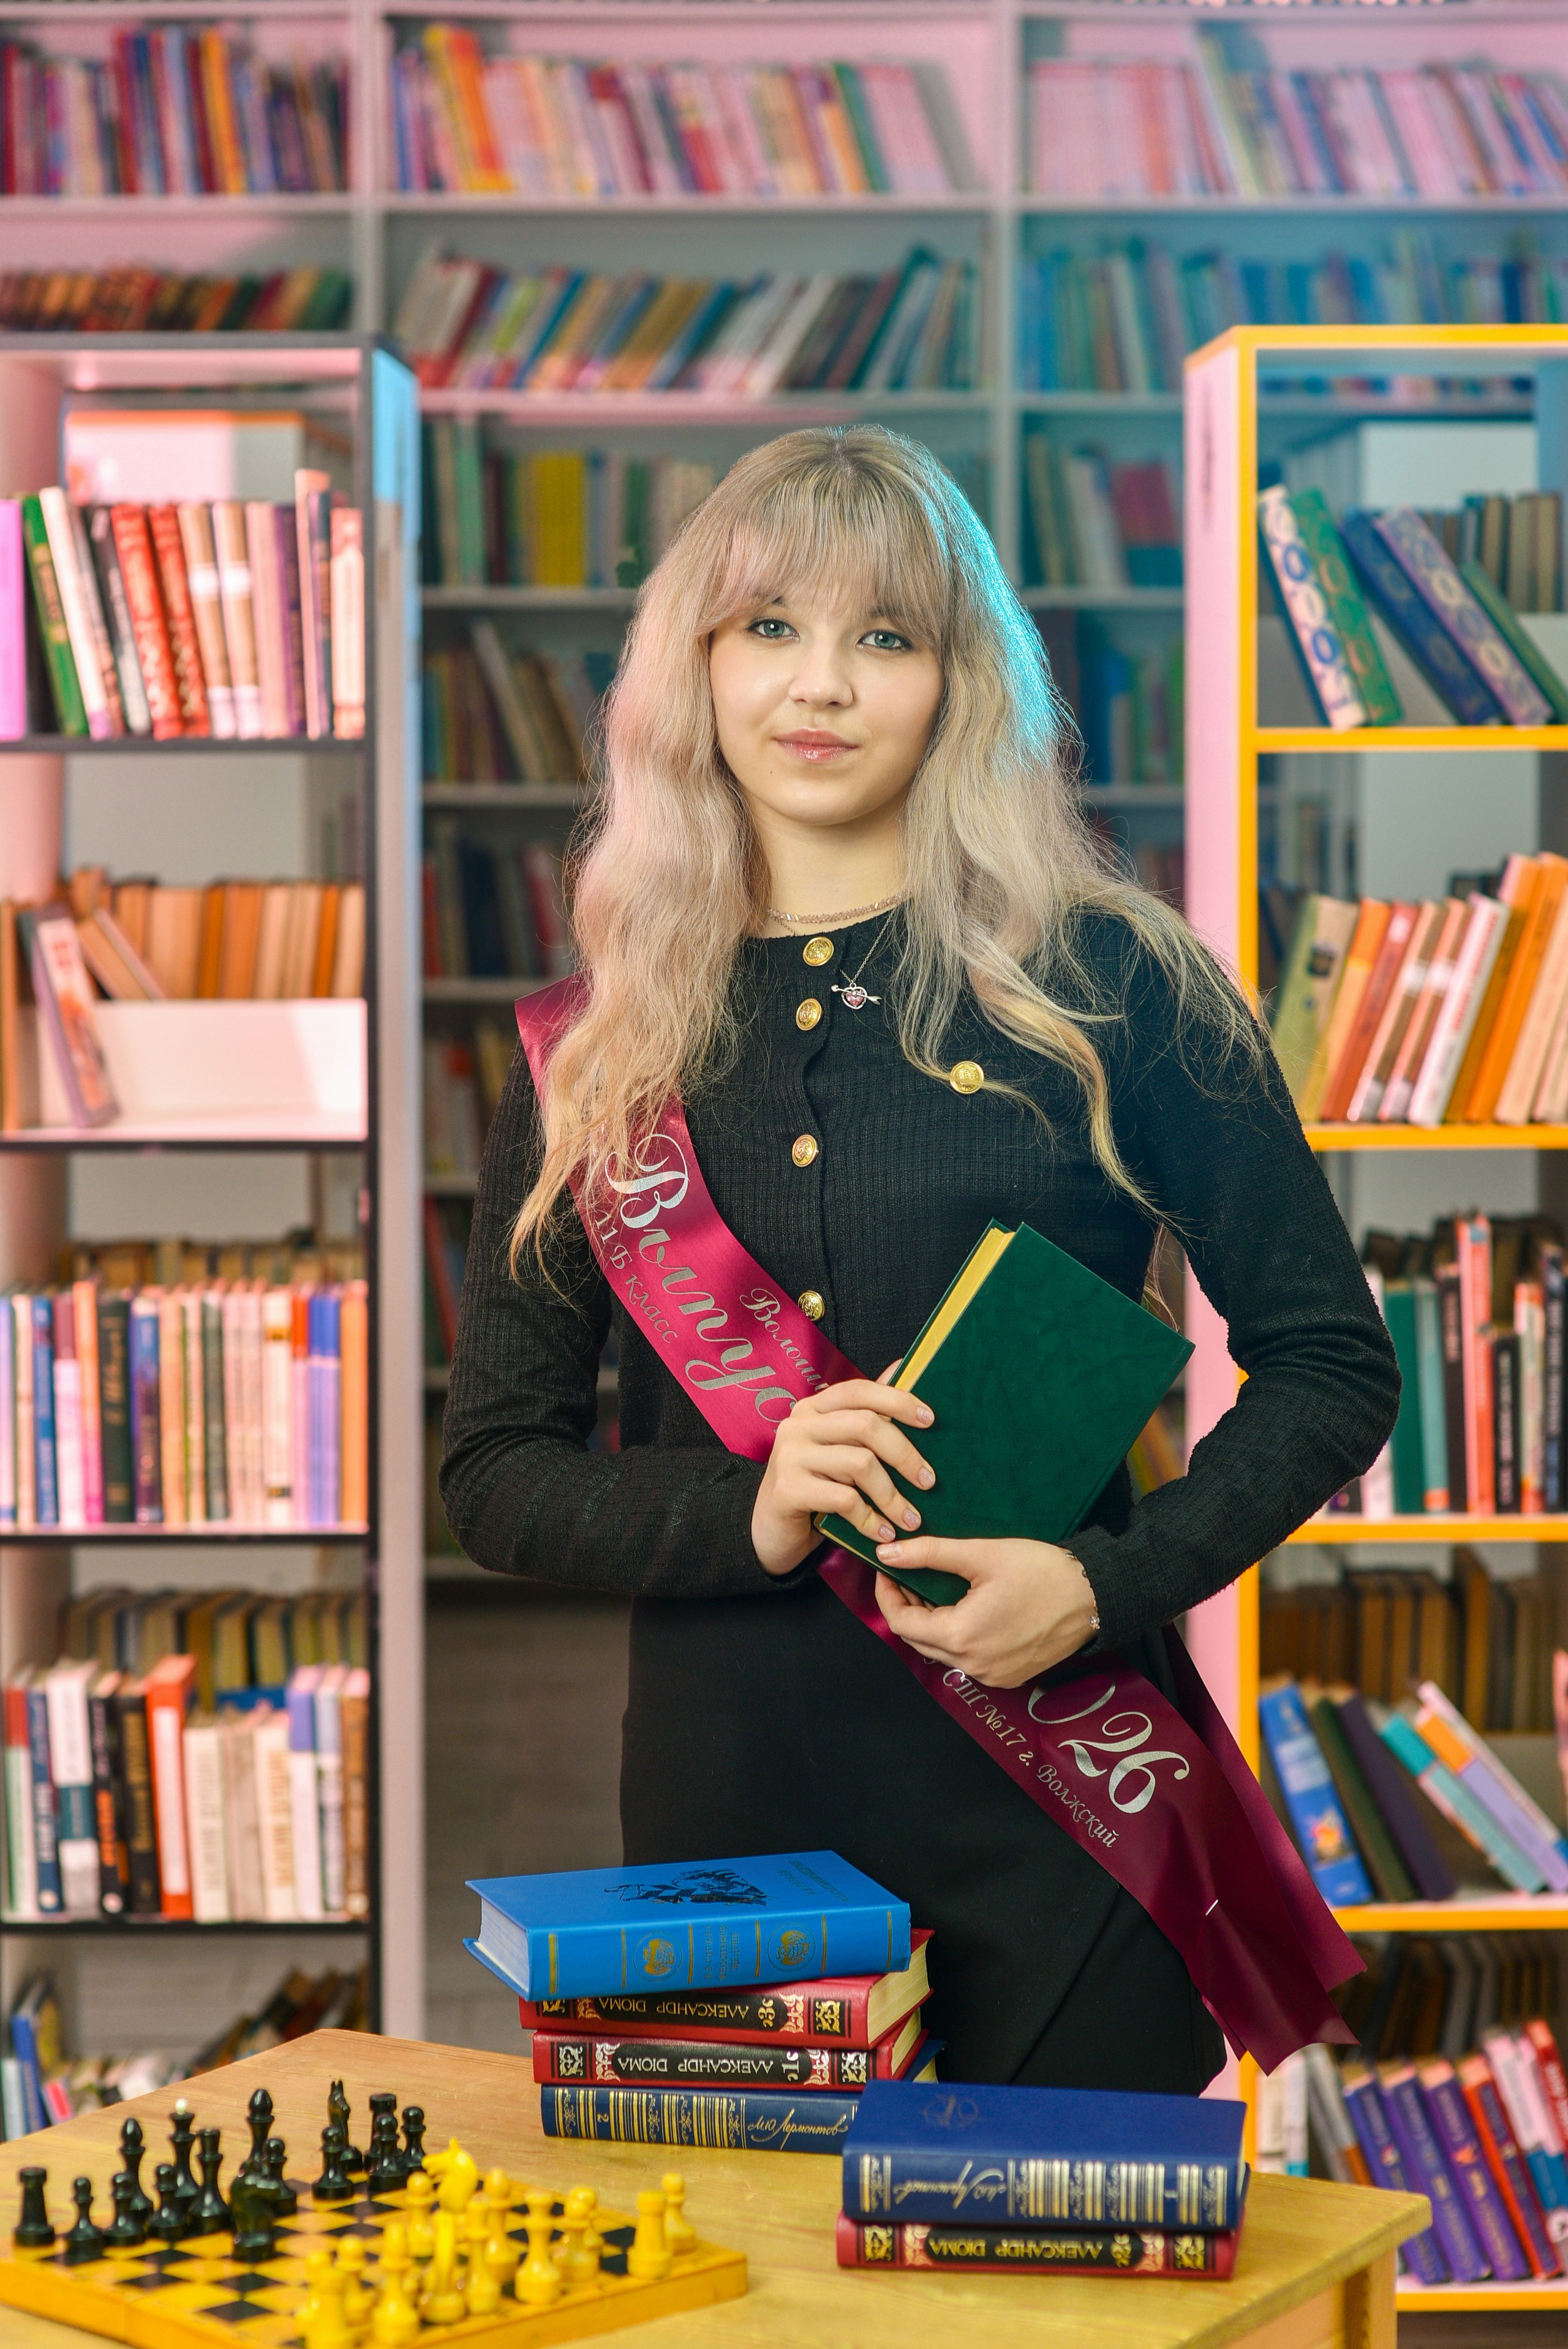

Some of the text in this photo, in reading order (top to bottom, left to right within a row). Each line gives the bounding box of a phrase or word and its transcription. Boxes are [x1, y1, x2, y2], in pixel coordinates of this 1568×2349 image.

[604, 1133, 797, 1434] Выпус
[609, 1245, 634, 1270] Б
[625, 1273, 679, 1344] класс
[943, 1668, 989, 1708] СШ
[1036, 1764, 1119, 1848] Волжский
[1027, 1675, 1190, 1814] 026
[751, 2108, 849, 2151] Лермонтов
